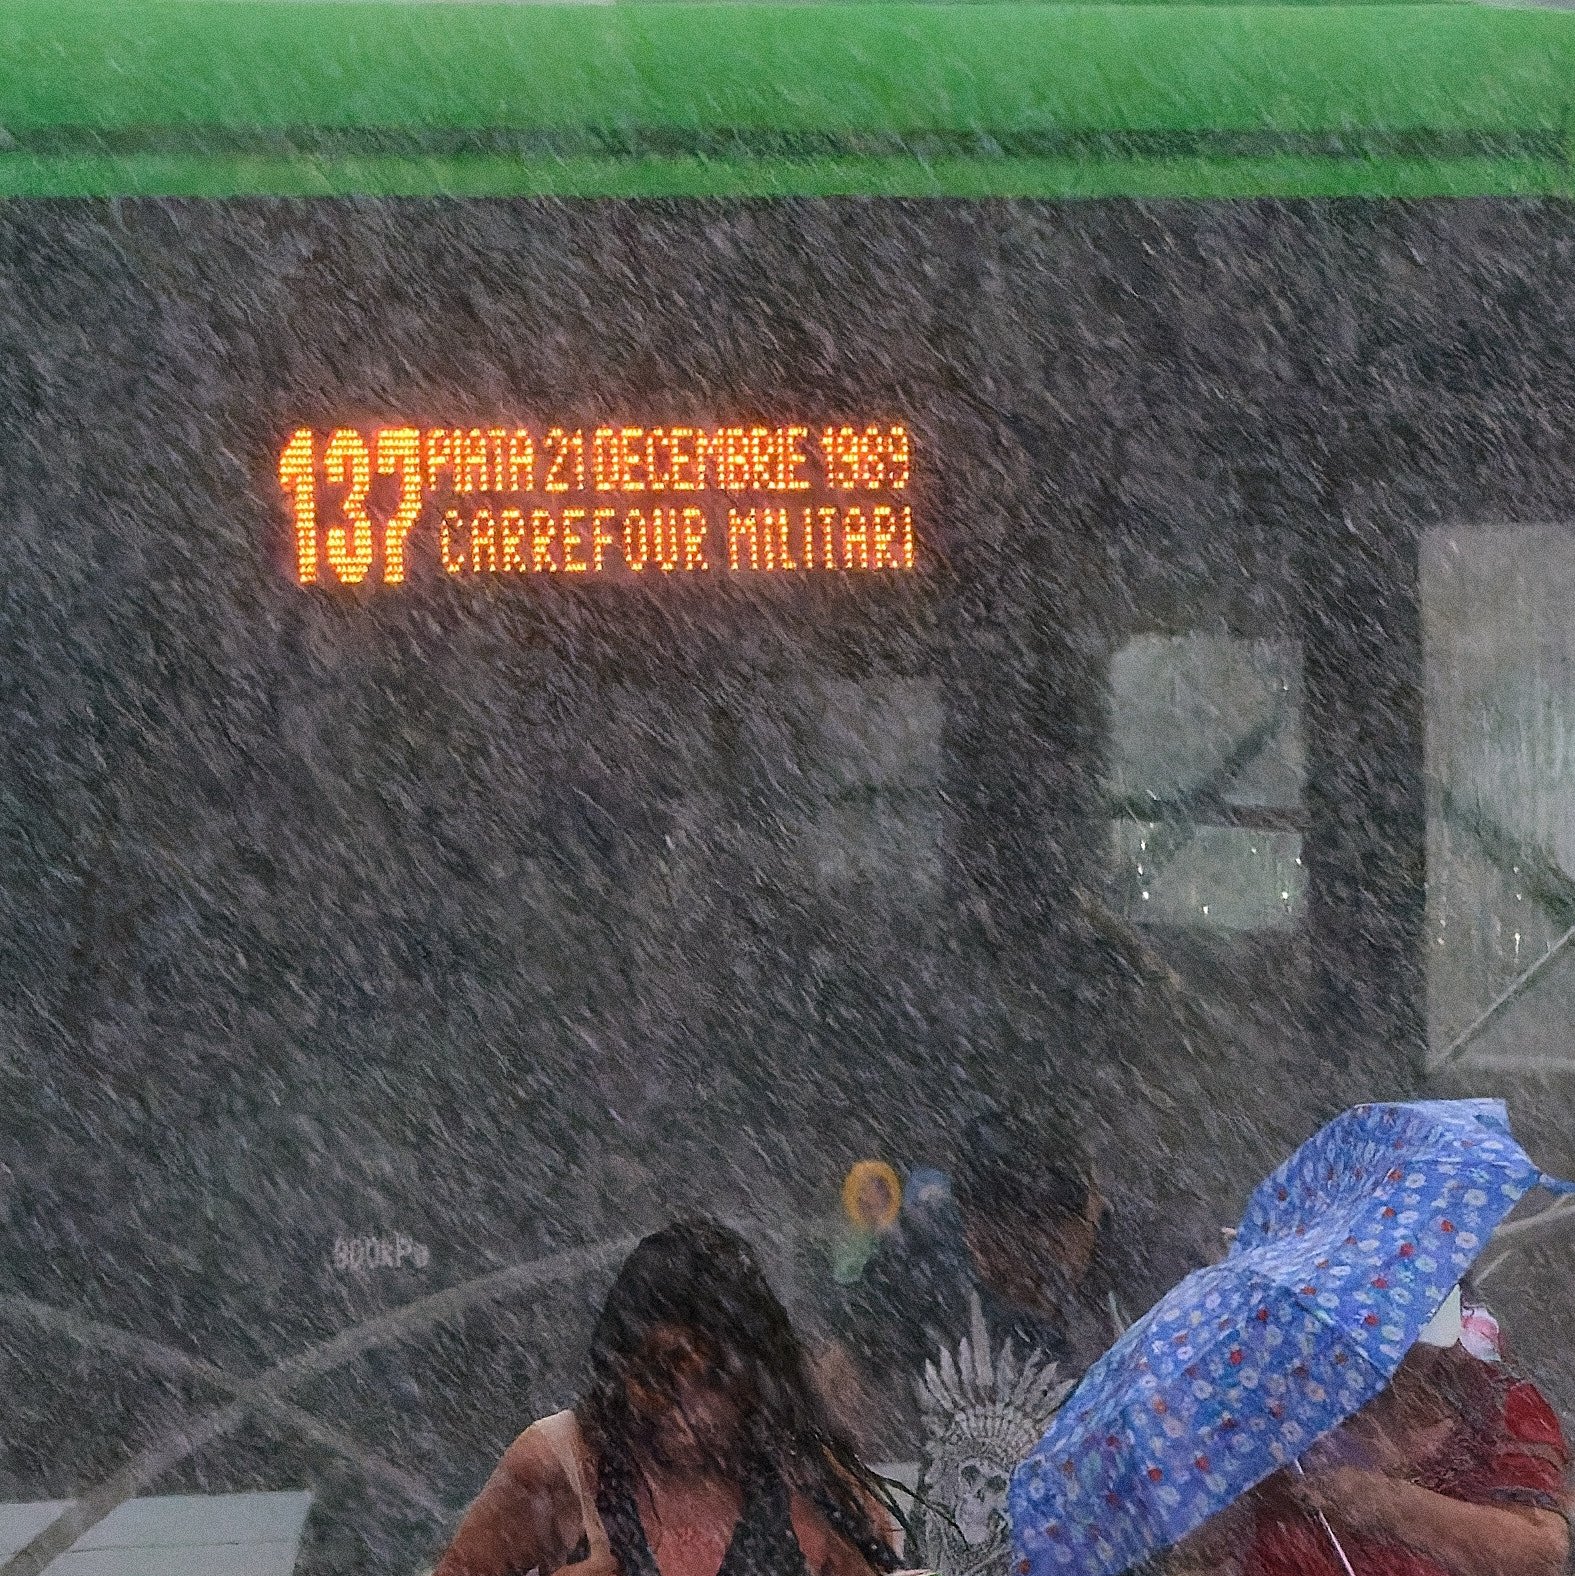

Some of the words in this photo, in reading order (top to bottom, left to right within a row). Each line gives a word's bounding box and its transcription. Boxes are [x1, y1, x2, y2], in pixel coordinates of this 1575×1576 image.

[427, 427, 534, 491] PIATA
[545, 427, 586, 491] 21
[594, 426, 810, 490] DECEMBRIE
[823, 425, 909, 489] 1989
[279, 426, 423, 584] 137
[440, 507, 709, 573] CARREFOUR
[728, 506, 913, 571] MILITARI
